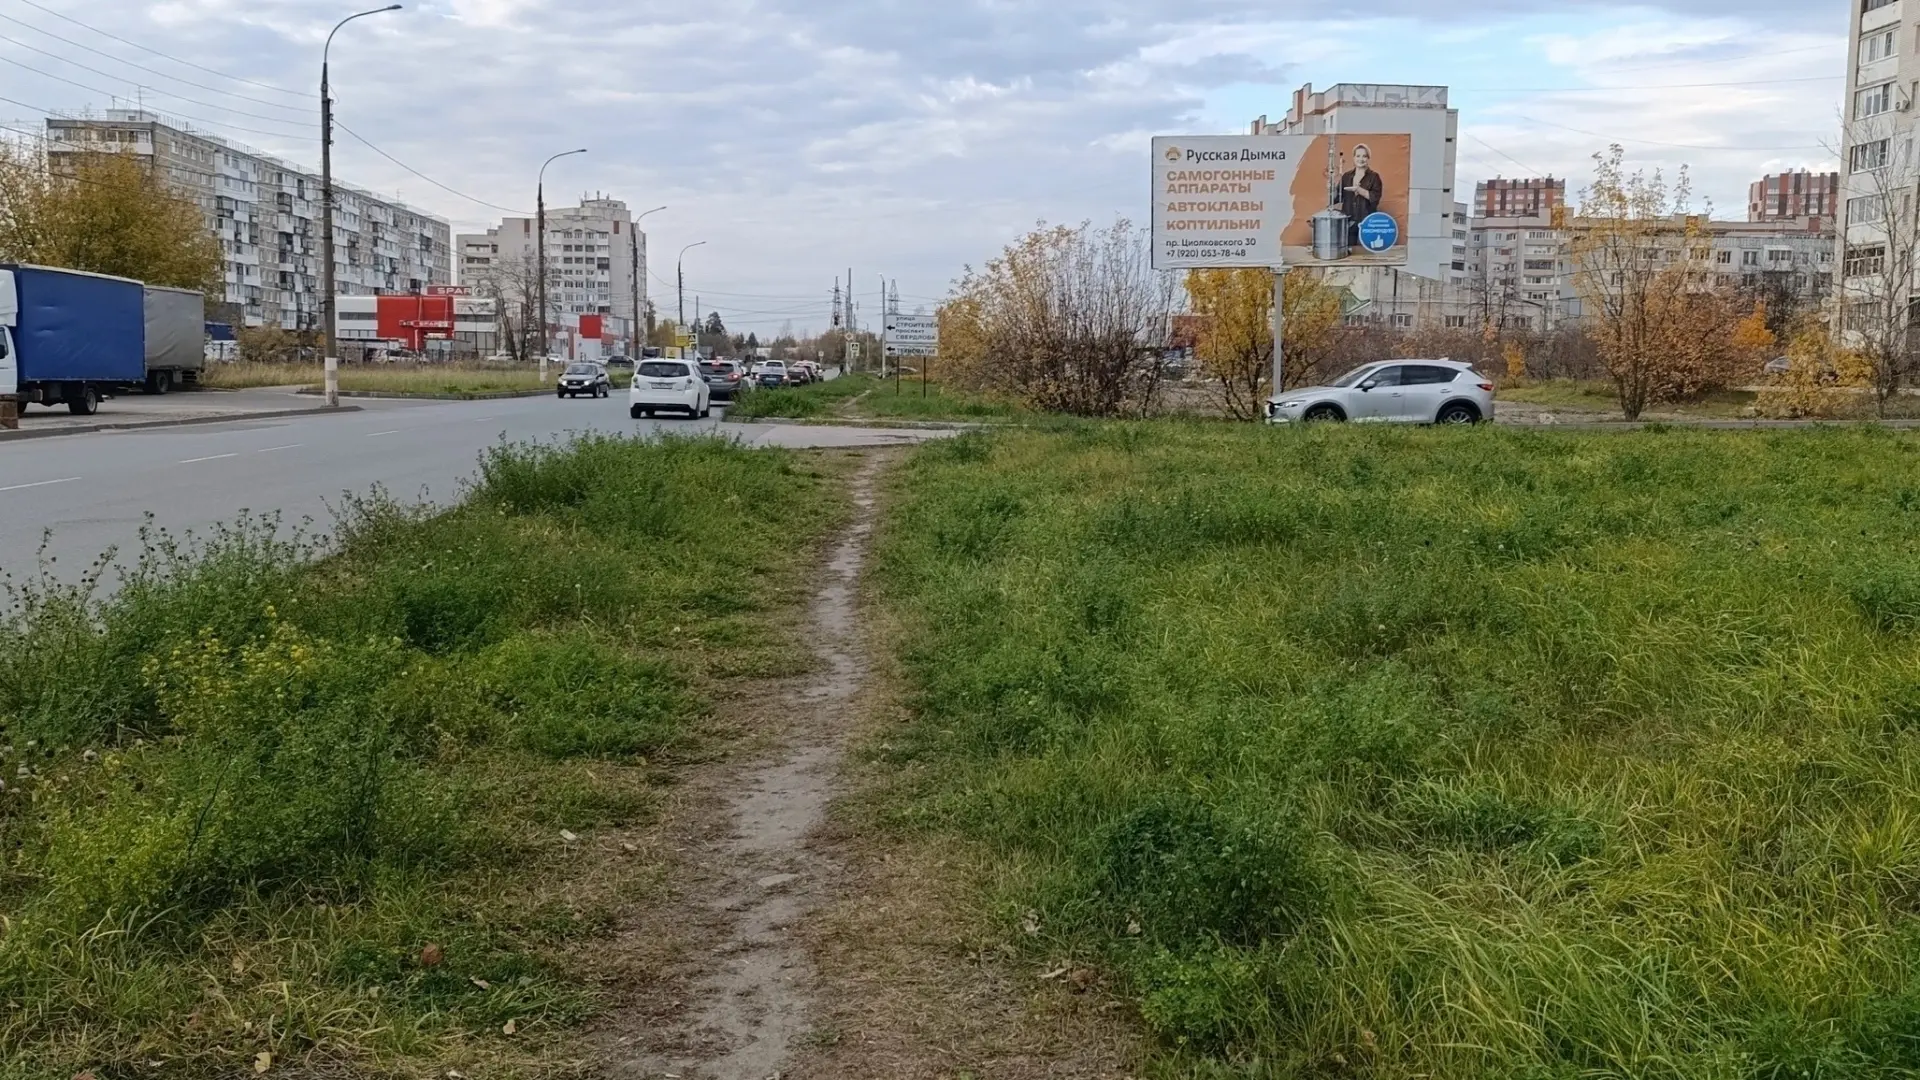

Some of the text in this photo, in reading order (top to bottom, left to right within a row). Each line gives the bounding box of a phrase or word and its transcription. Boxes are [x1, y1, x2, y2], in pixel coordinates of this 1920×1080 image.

[1186, 148, 1286, 164] Русская Дымка
[1166, 170, 1275, 181] САМОГОННЫЕ
[1166, 183, 1251, 194] АППАРАТЫ
[1166, 201, 1263, 212] АВТОКЛАВЫ
[1166, 219, 1261, 230] КОПТИЛЬНИ
[1166, 238, 1257, 248] пр. Циолковского 30
[1166, 249, 1247, 258] +7 (920) 053-78-48
[437, 287, 471, 295] SPAR
